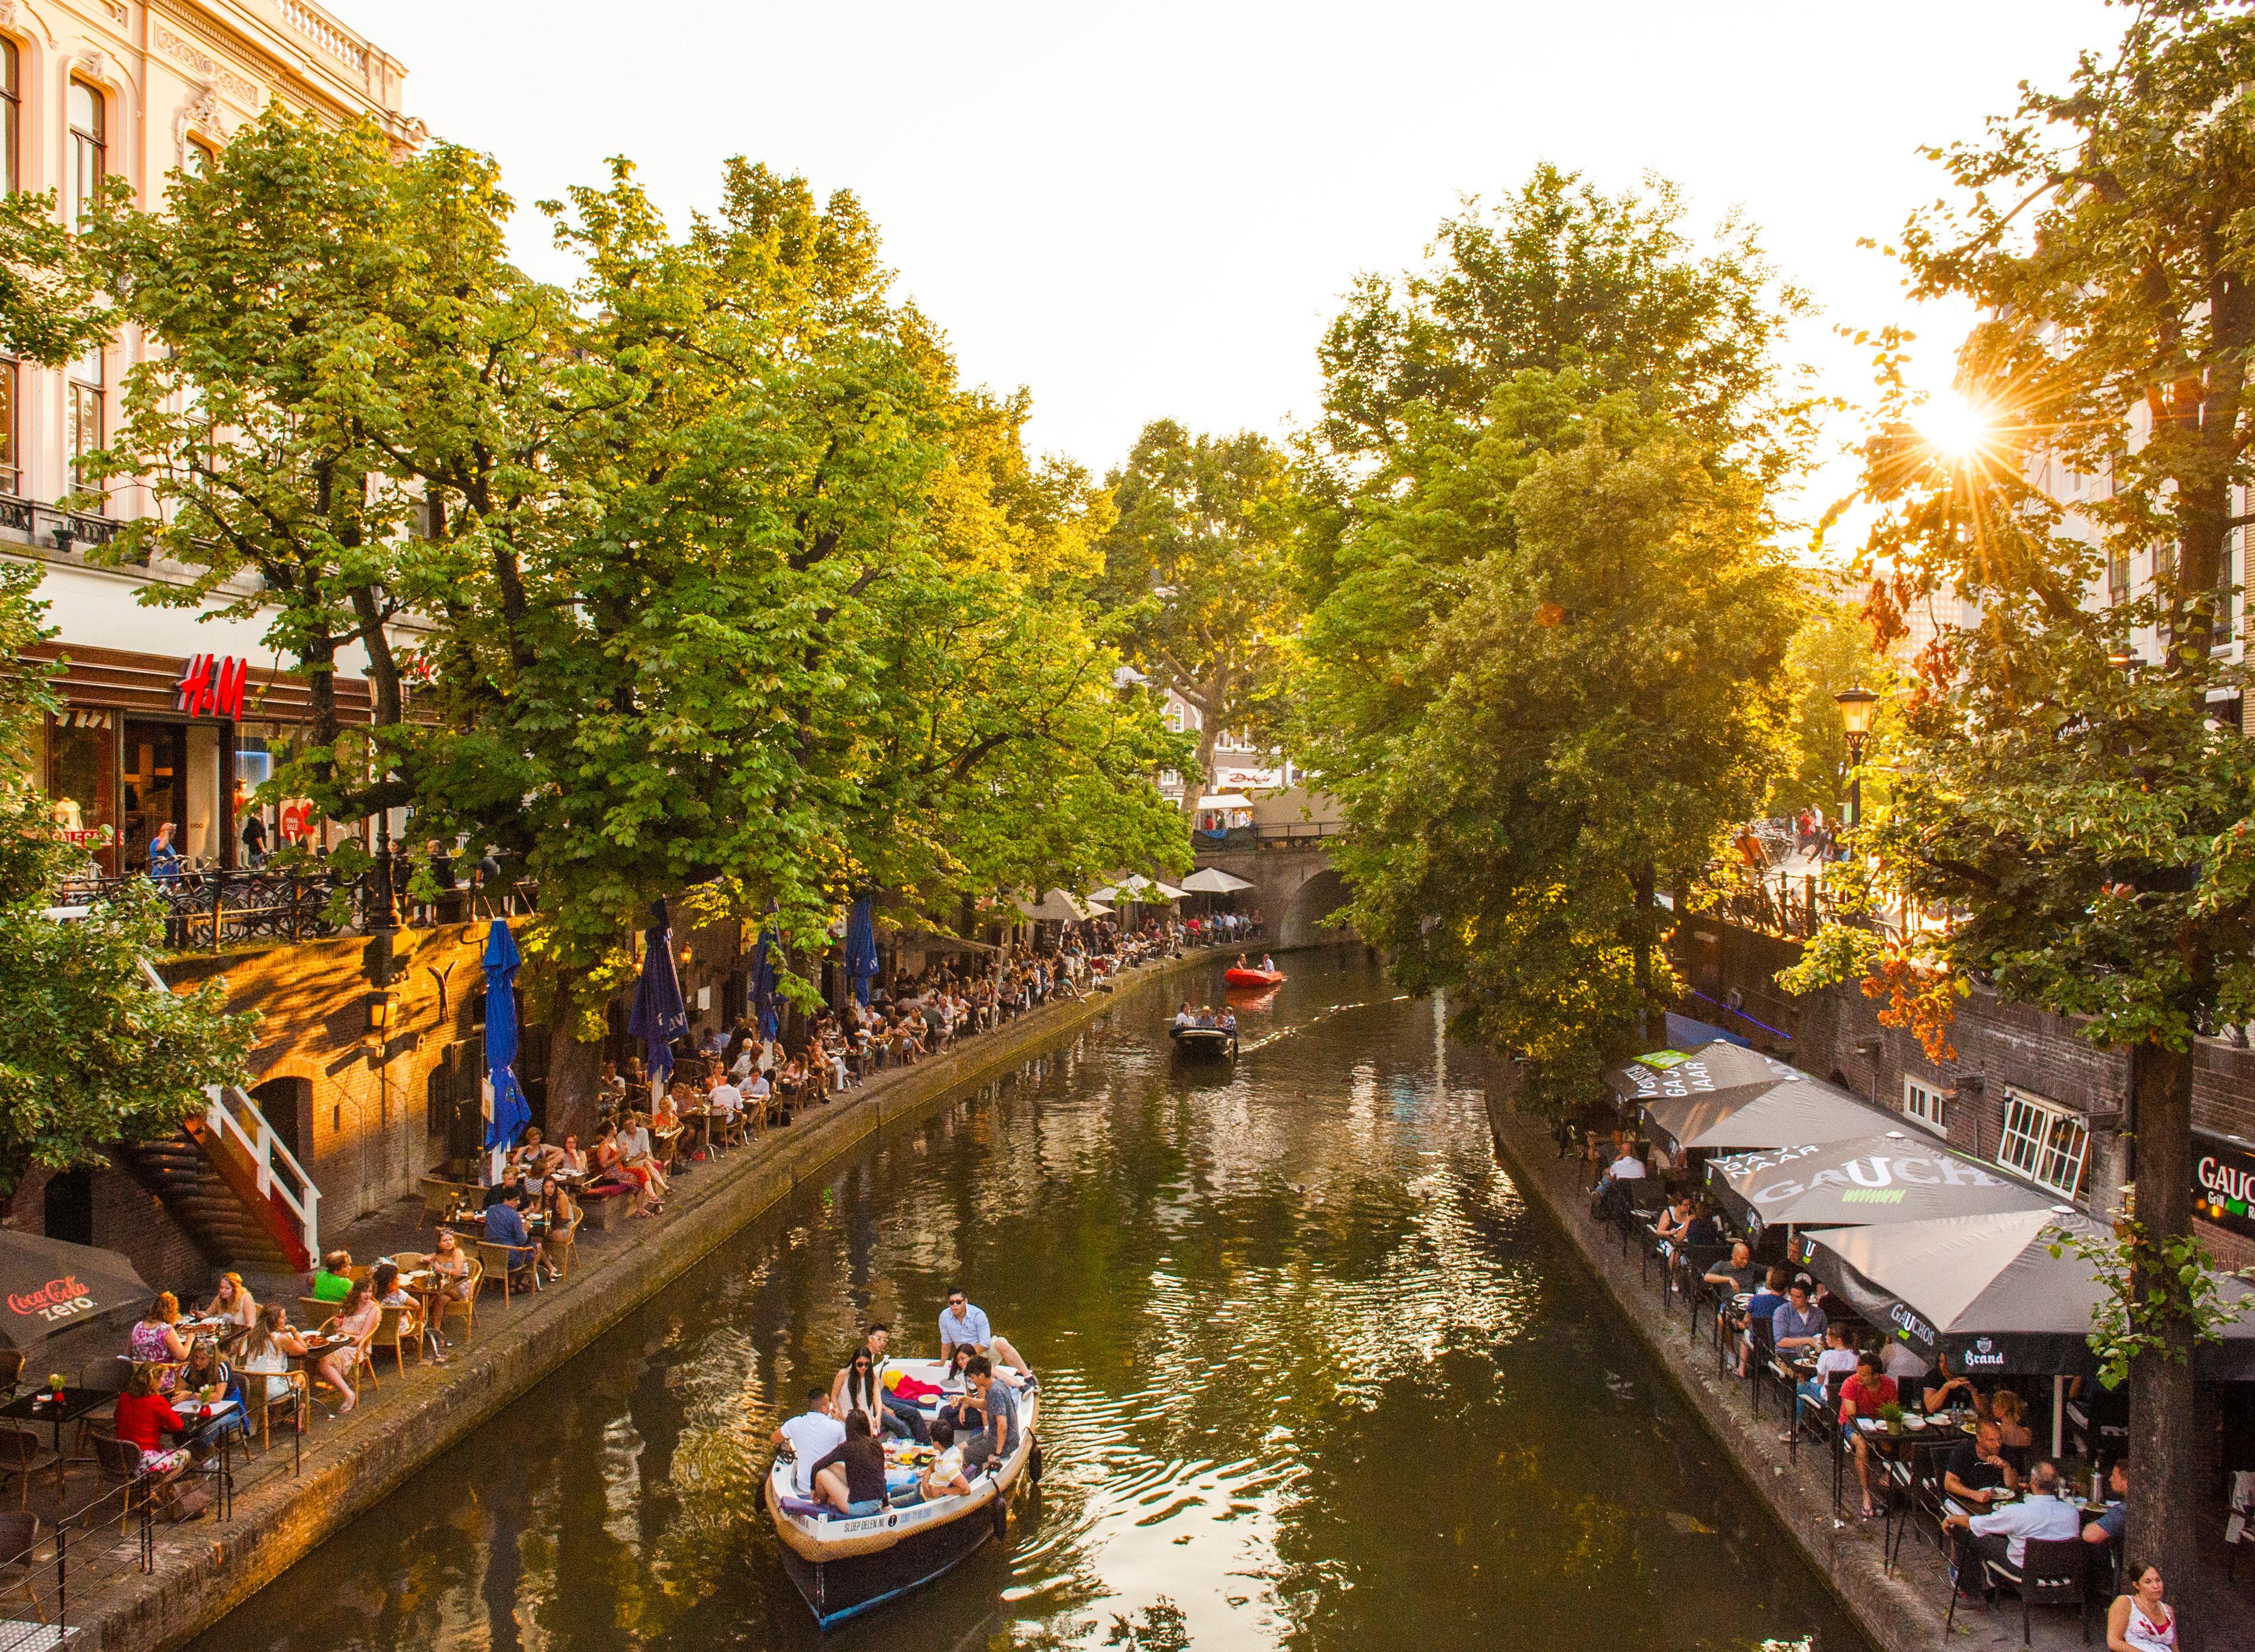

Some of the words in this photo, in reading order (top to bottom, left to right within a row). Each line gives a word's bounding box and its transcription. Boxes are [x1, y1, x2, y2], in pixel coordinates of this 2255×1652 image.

[178, 653, 247, 722] H&M
[1729, 1145, 1819, 1179] NAAR
[2208, 1191, 2225, 1208] Grill
[1891, 1303, 1935, 1346] GAUCHOS
[1965, 1349, 2004, 1366] Brand
